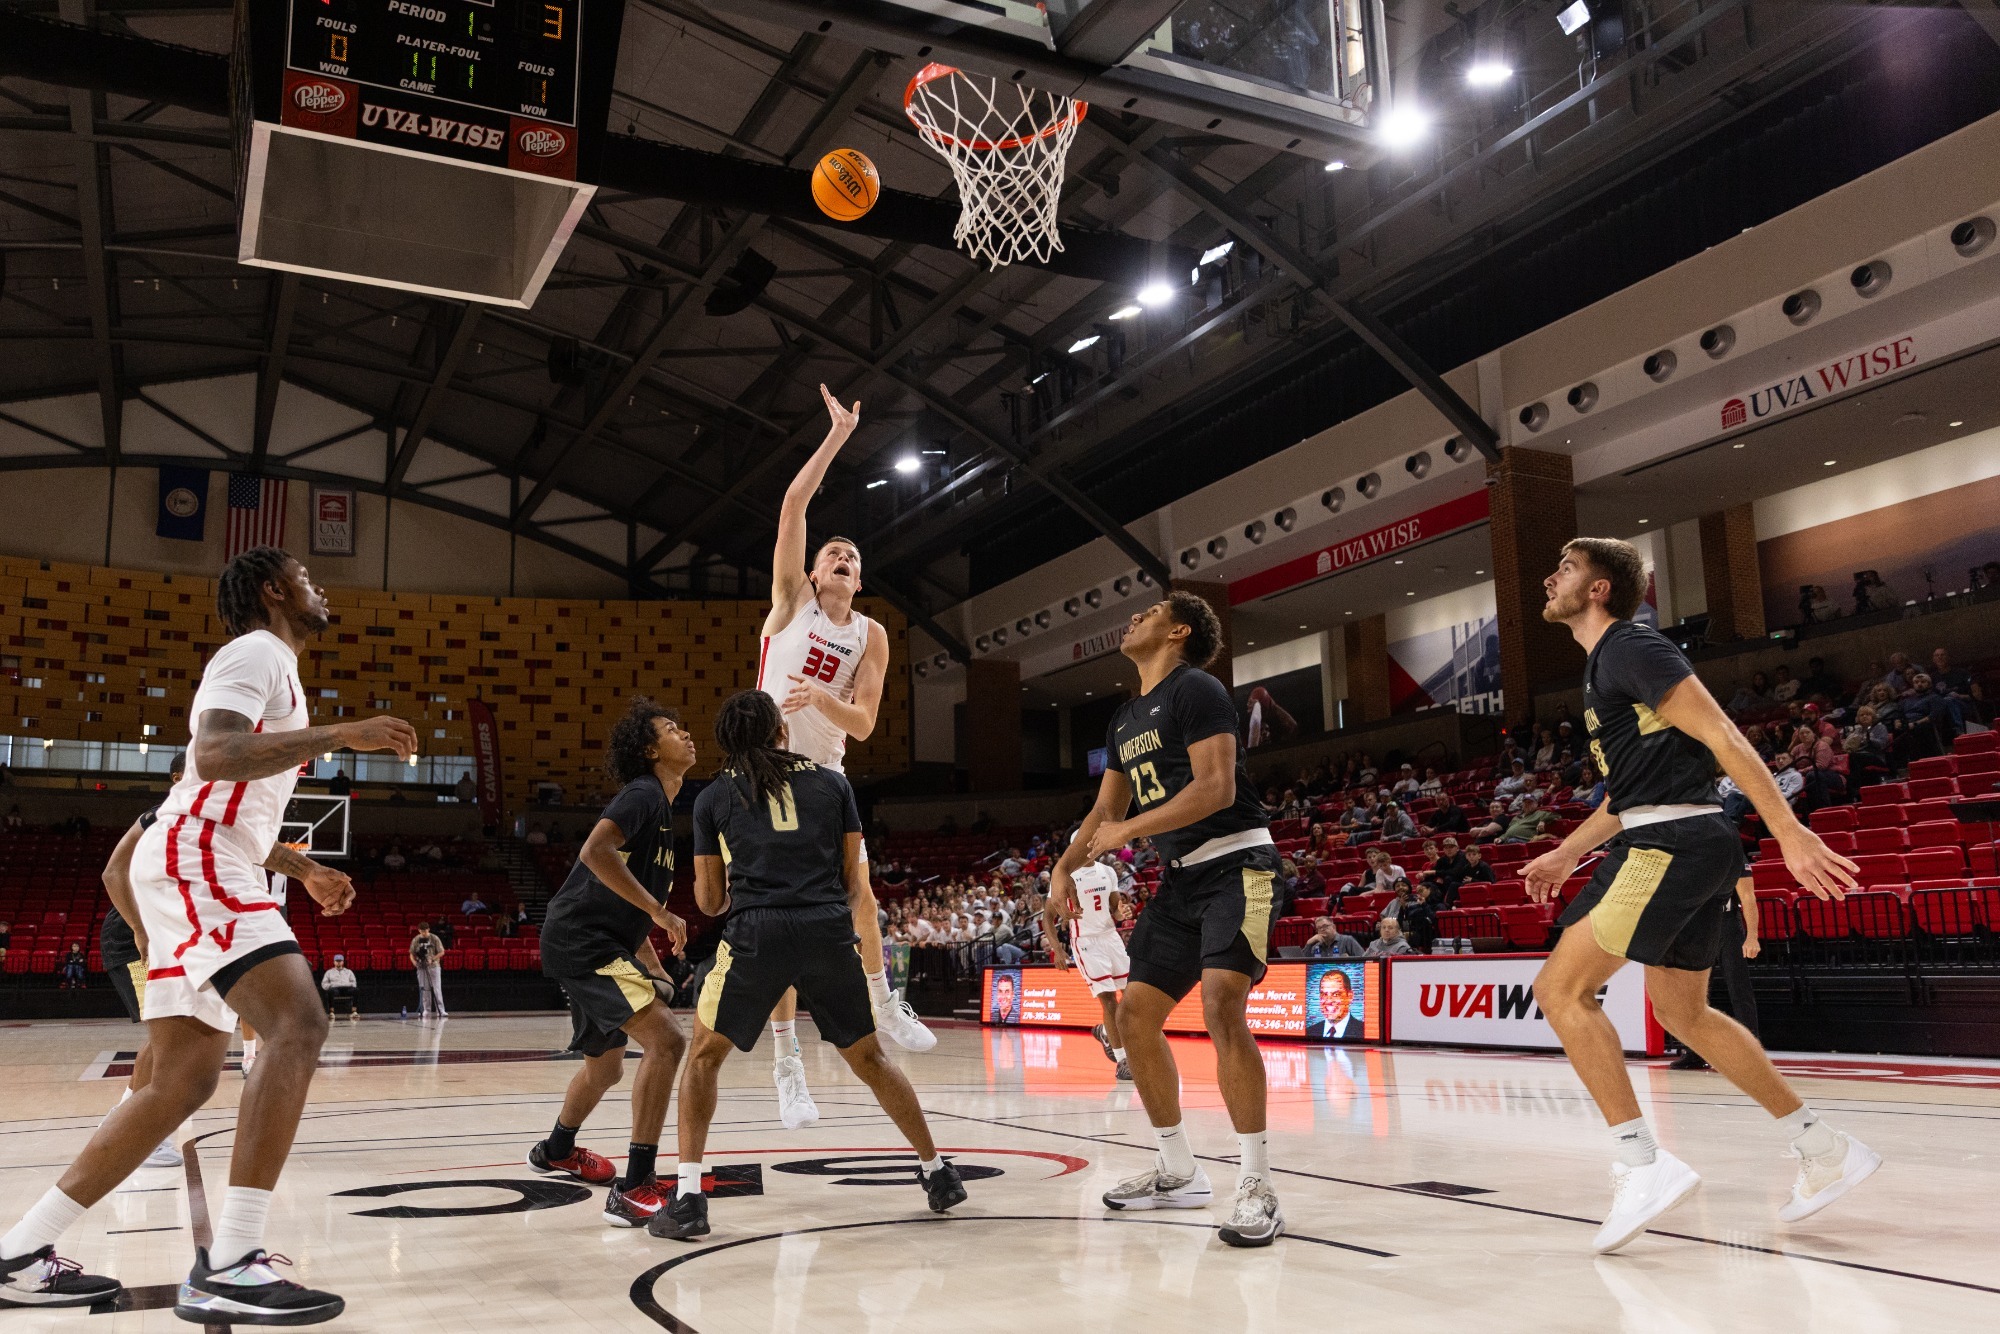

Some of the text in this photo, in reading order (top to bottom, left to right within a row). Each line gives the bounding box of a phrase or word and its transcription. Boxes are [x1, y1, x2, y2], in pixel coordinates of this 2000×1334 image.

[388, 0, 447, 23] PERIOD
[542, 4, 563, 40] 3
[316, 17, 358, 34] FOULS
[330, 33, 348, 62] 0
[396, 34, 482, 61] PLAYER-FOUL
[320, 61, 349, 76] WON
[518, 61, 555, 77] FOULS
[313, 85, 331, 98] Dr
[399, 78, 437, 94] GAME
[299, 86, 342, 109] Pepper
[520, 103, 548, 117] WON
[361, 103, 506, 151] UVA-WISE
[537, 131, 553, 142] Dr
[524, 132, 562, 153] Pepper
[828, 157, 862, 198] Wilson
[1749, 336, 1918, 418] UVA WISE
[321, 523, 347, 535] UVA
[319, 537, 348, 548] WISE
[1332, 518, 1422, 569] UVA WISE
[808, 631, 853, 657] UVAWISE
[1083, 636, 1105, 657] UVA
[802, 646, 841, 684] 33
[1119, 728, 1163, 765] ANDERSON
[478, 723, 496, 803] CAVALIERS
[1093, 894, 1102, 911] 2
[1247, 990, 1297, 1000] ohn Moretz
[1292, 1004, 1303, 1015] VA
